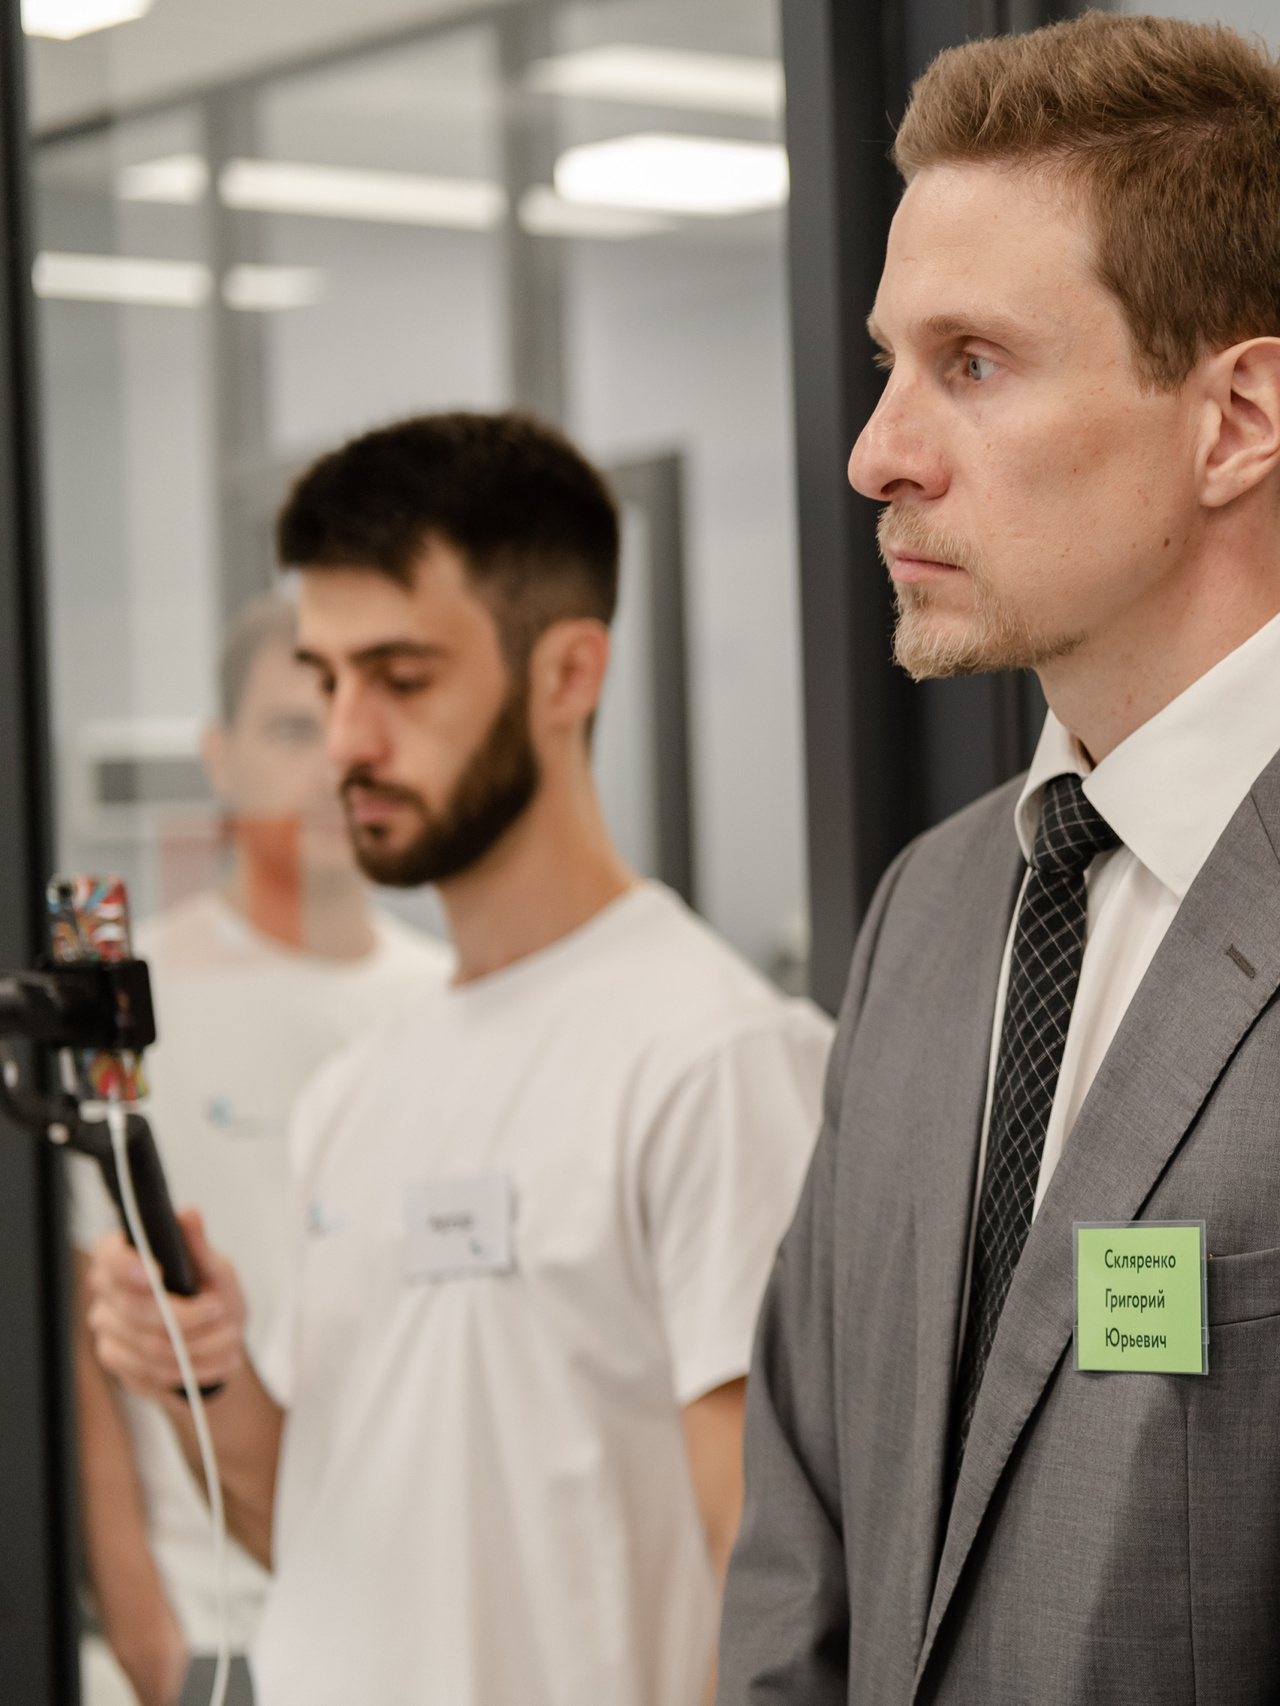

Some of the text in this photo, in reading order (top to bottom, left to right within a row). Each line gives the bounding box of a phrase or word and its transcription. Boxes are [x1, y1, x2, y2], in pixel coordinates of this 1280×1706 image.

[1104, 1248, 1177, 1273] Скляренко
[1104, 1288, 1166, 1313] Григорий
[1104, 1327, 1167, 1352] Юрьевич
